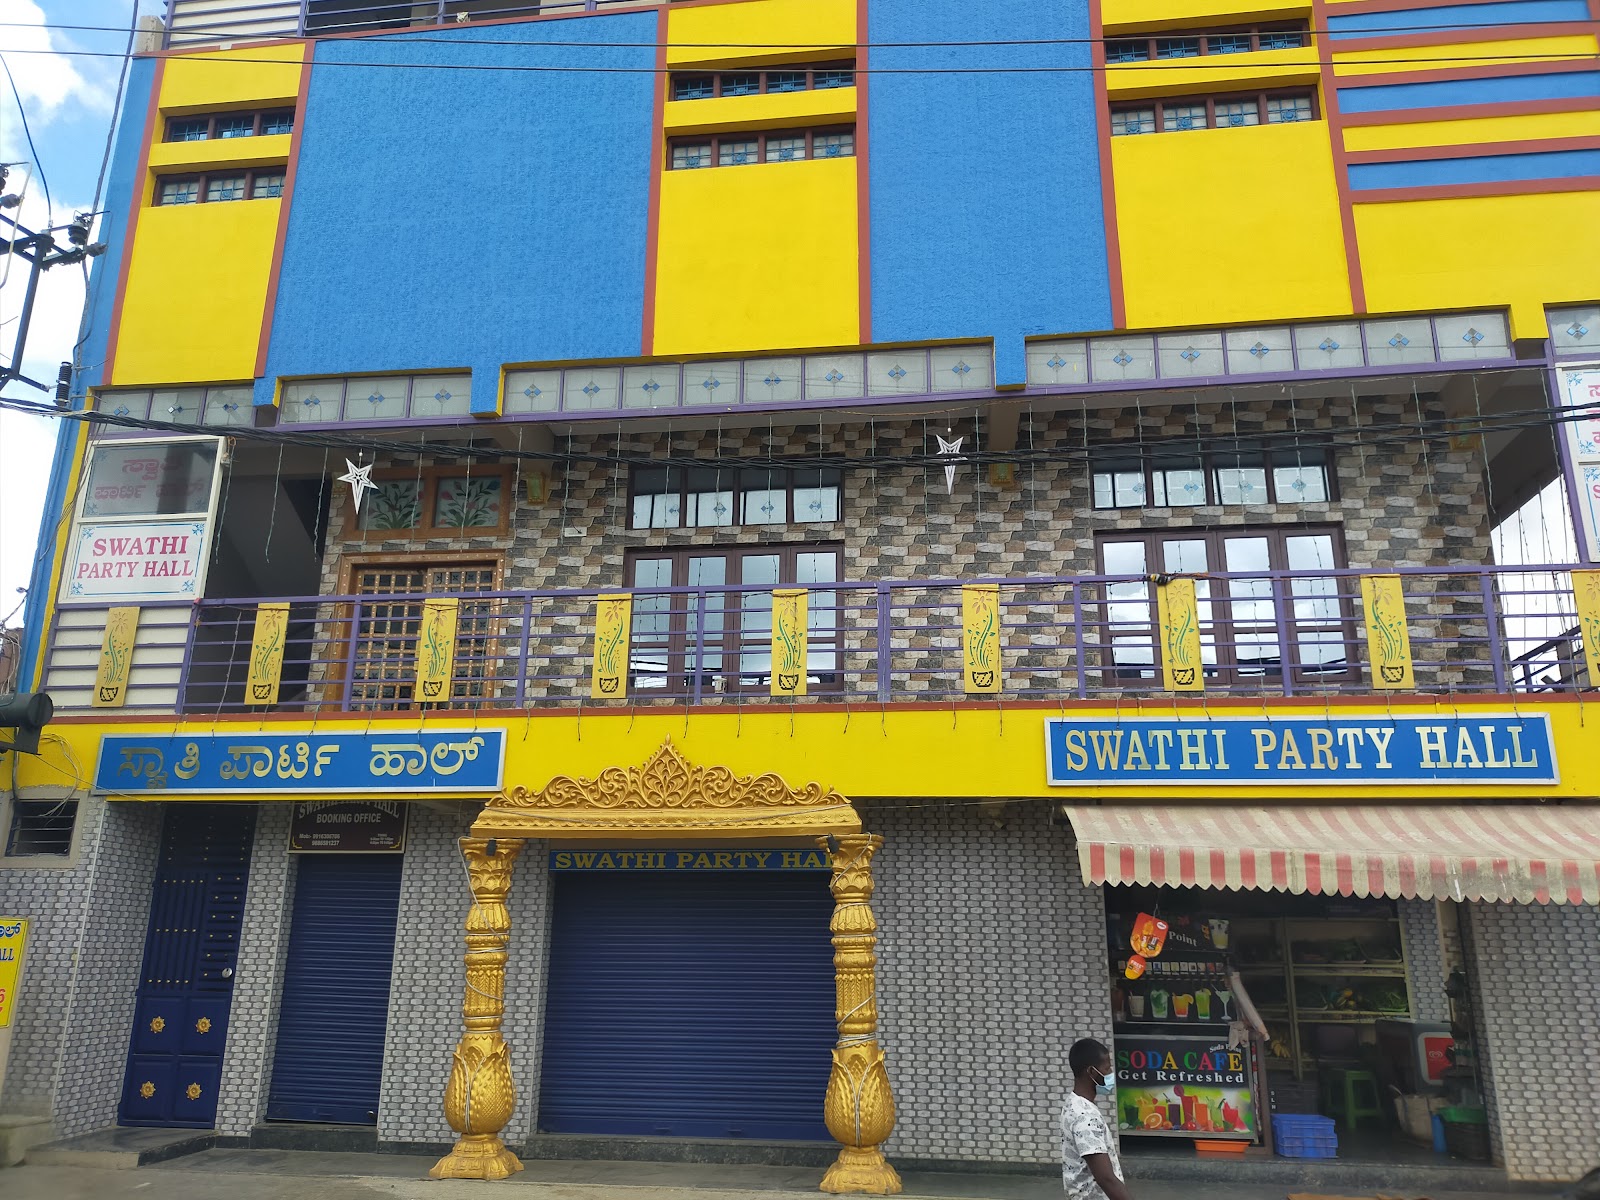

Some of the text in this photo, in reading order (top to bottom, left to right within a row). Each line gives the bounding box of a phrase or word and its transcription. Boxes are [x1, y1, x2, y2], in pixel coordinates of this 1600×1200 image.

[92, 536, 189, 557] SWATHI
[77, 560, 193, 578] PARTY HALL
[369, 736, 485, 776] ಹಾಲ್
[1065, 726, 1538, 772] SWATHI PARTY HALL
[316, 813, 381, 824] BOOKING OFFICE
[555, 852, 666, 869] SWATHI
[676, 852, 772, 869] PARTY
[1168, 930, 1198, 947] Point
[1118, 1050, 1243, 1071] SODA CAFE
[1118, 1069, 1244, 1083] Get Refreshed
